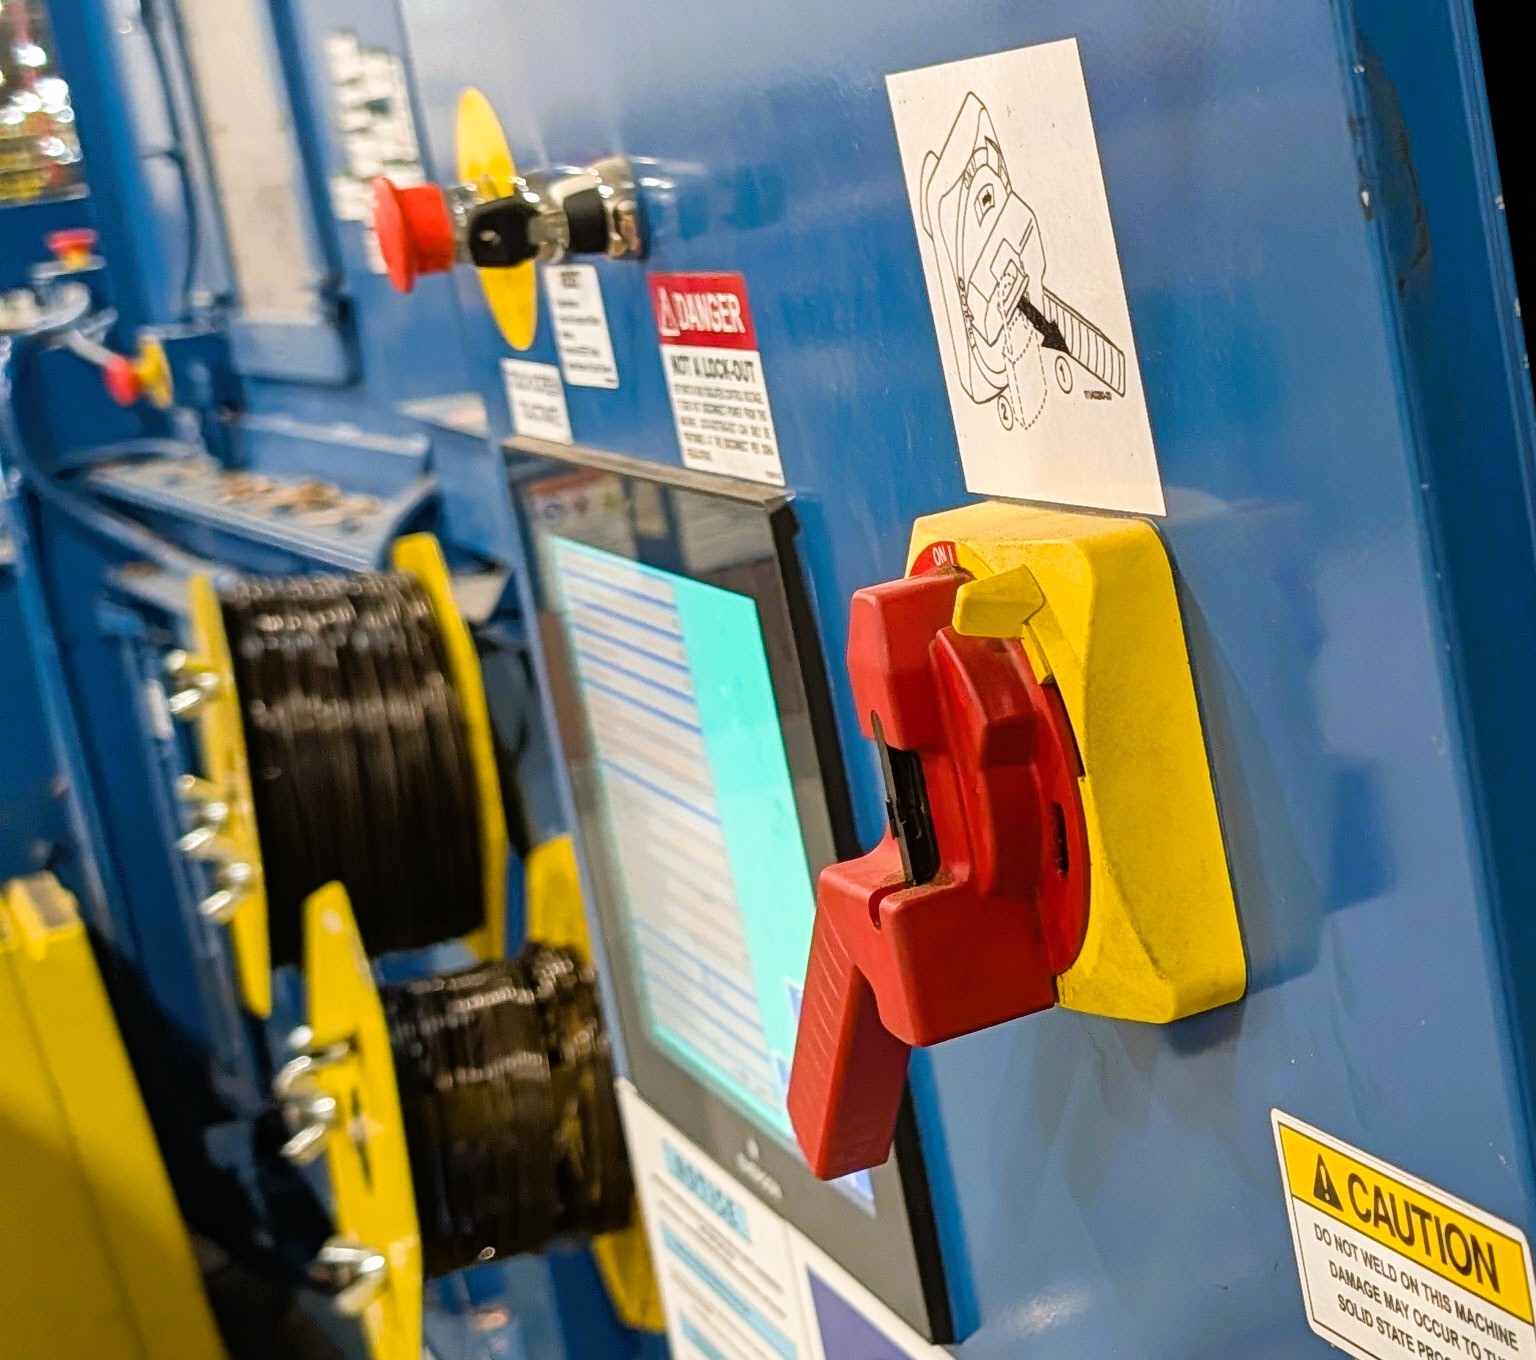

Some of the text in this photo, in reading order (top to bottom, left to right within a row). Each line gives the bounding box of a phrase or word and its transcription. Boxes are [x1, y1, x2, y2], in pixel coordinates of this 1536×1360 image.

[674, 292, 744, 332] DANGER
[932, 545, 947, 566] ON
[1347, 1173, 1499, 1292] CAUTION
[1313, 1222, 1518, 1351] DO NOT WELD ON THIS MACHINE
[1328, 1260, 1381, 1304] DAMAGE
[1383, 1290, 1409, 1319] MAY
[1413, 1308, 1460, 1349] OCCUR
[1461, 1335, 1481, 1360] TO
[1337, 1293, 1373, 1327] SOLID
[1375, 1316, 1415, 1352] STATE
